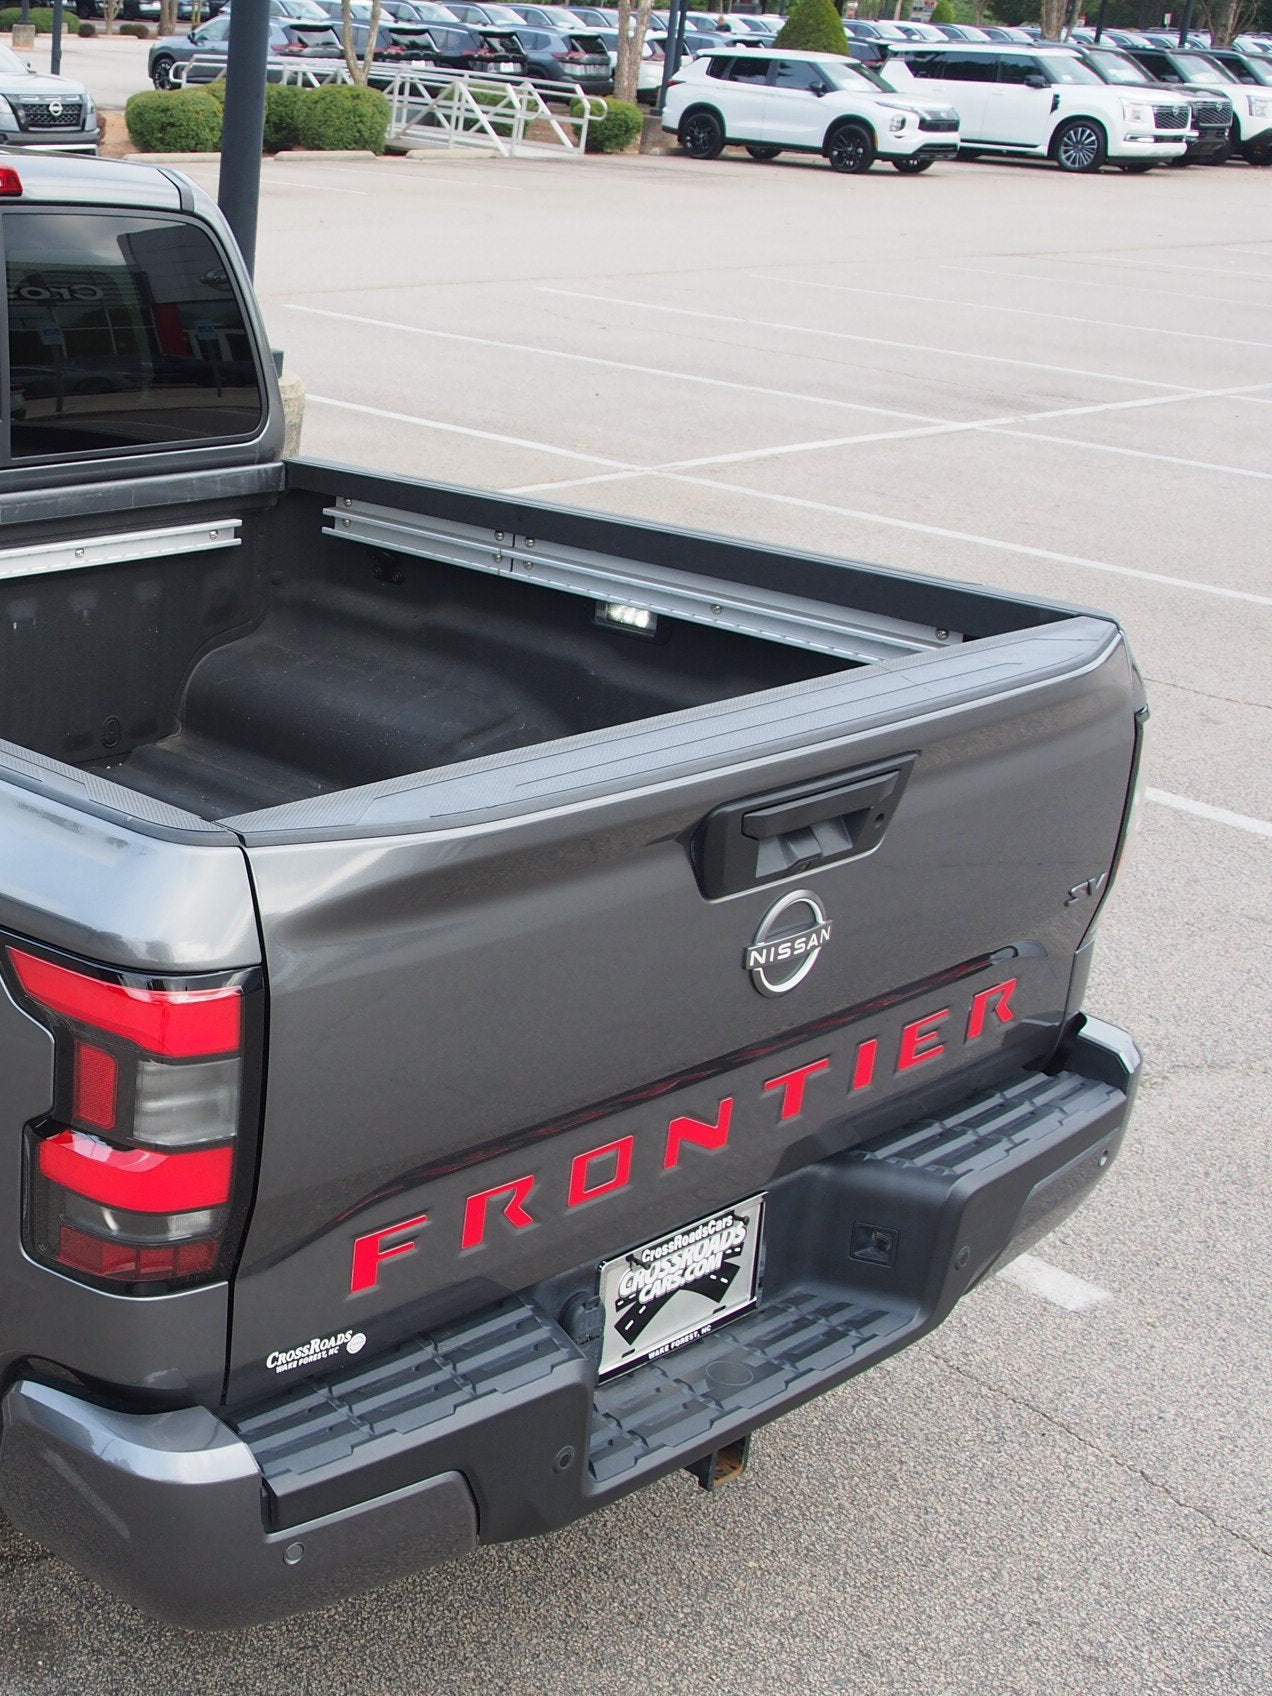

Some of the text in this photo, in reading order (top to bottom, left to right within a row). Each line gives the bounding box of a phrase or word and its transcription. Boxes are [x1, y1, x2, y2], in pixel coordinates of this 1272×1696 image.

[749, 925, 831, 966] NISSAN
[350, 977, 1018, 1294] FRONTIER
[619, 1223, 747, 1298] CROSSROADS
[641, 1215, 733, 1263] CrossRoadsCars
[639, 1253, 724, 1304] CARS.COM
[275, 1362, 298, 1374] WAKE
[328, 1346, 340, 1356] NC
[648, 1345, 670, 1360] WAKE
[701, 1325, 712, 1335] NC
